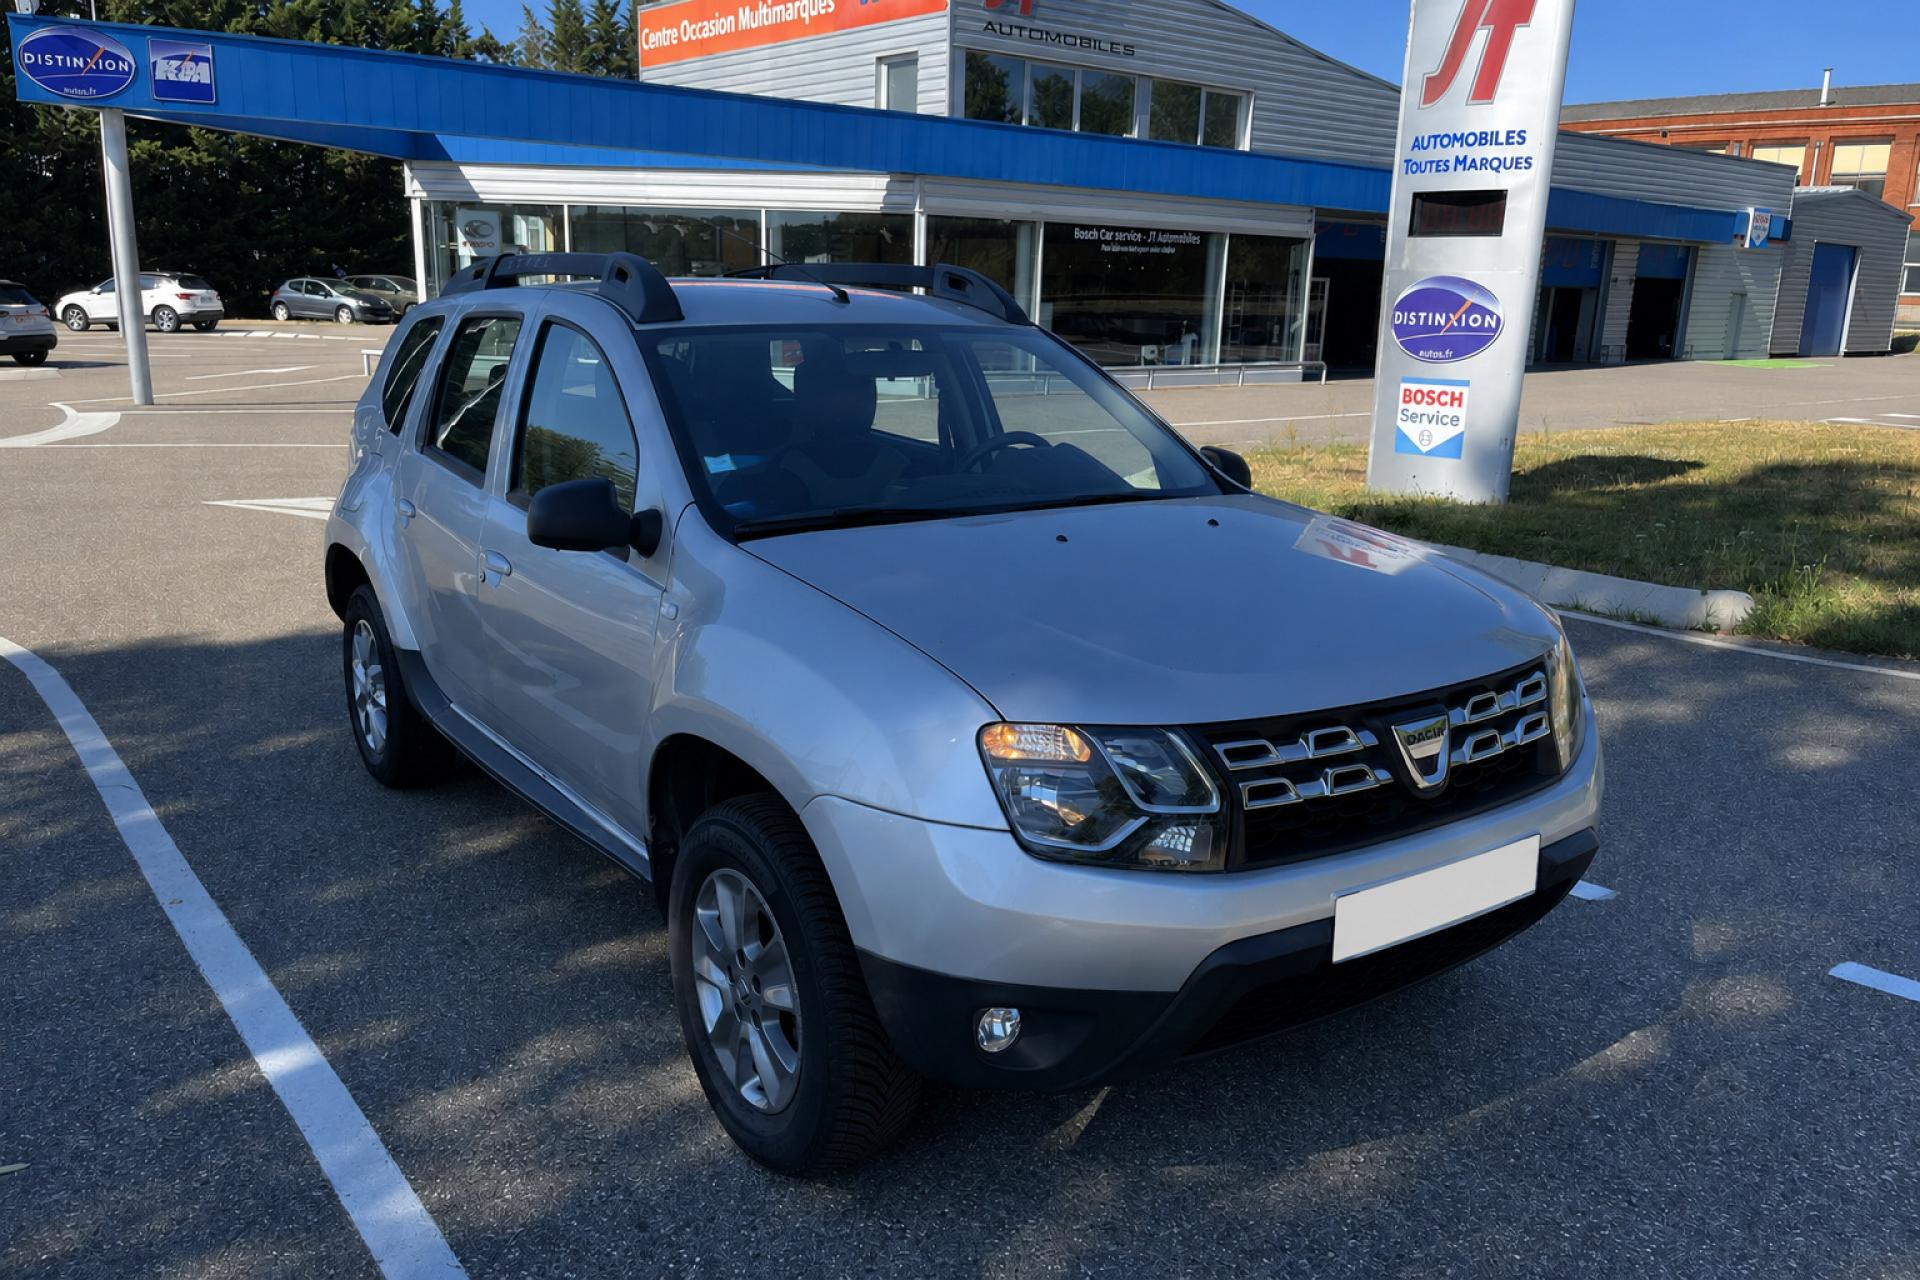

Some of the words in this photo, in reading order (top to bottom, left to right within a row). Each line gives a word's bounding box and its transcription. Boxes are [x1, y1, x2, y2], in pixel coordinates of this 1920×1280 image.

[642, 27, 678, 50] Centre
[680, 12, 735, 41] Occasion
[738, 0, 835, 31] Multimarques
[983, 20, 1135, 56] AUTOMOBILES
[24, 51, 129, 73] DISTINXION
[1411, 130, 1526, 151] AUTOMOBILES
[1074, 227, 1098, 240] Bosch
[1100, 229, 1113, 241] Car
[1394, 311, 1497, 329] DISTINXION
[1419, 349, 1453, 359] autos.fr
[1402, 388, 1463, 408] BOSCH
[1400, 409, 1460, 427] Service
